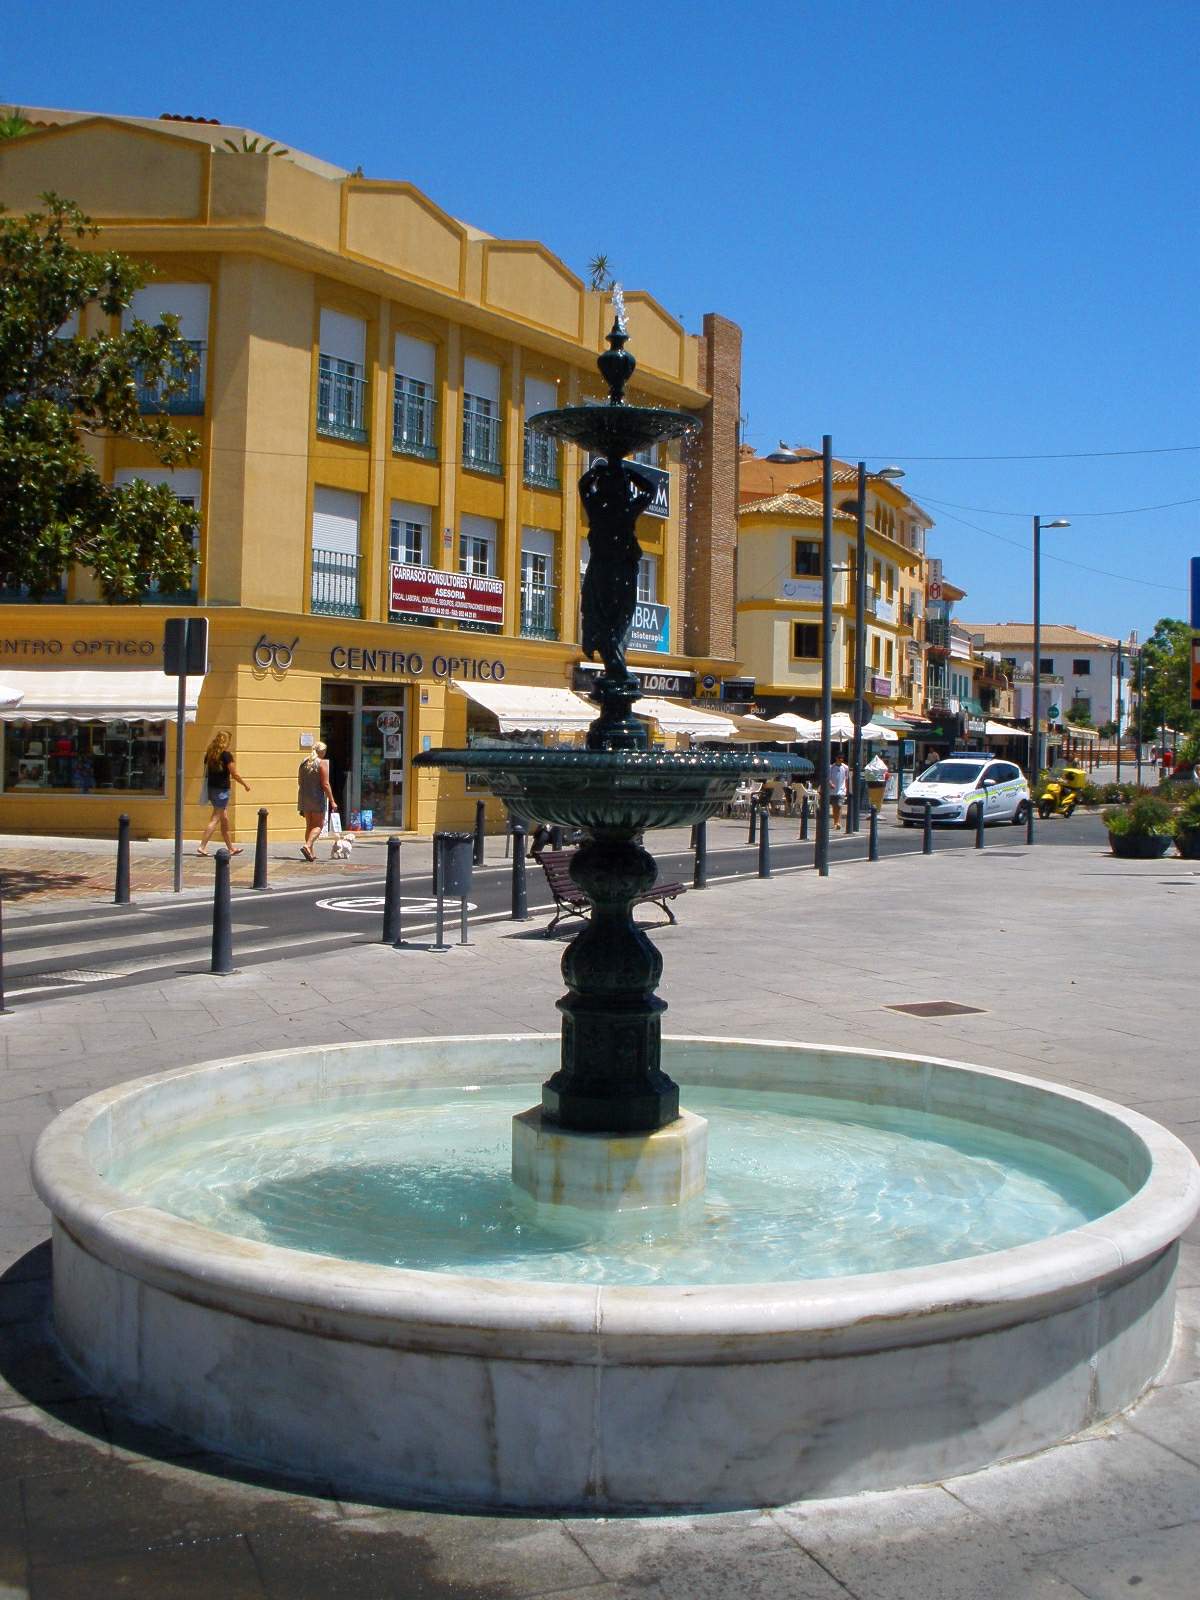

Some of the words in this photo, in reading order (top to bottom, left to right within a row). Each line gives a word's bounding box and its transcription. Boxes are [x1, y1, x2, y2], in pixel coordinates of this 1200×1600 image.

[393, 567, 426, 583] CARRASCO
[427, 572, 467, 589] CONSULTORES
[468, 579, 472, 589] Y
[472, 579, 502, 594] AUDITORES
[435, 588, 466, 600] ASESORIA
[72, 640, 155, 656] OPTICO
[330, 646, 424, 674] CENTRO
[432, 655, 506, 681] OPTICO
[643, 675, 680, 692] LORCA
